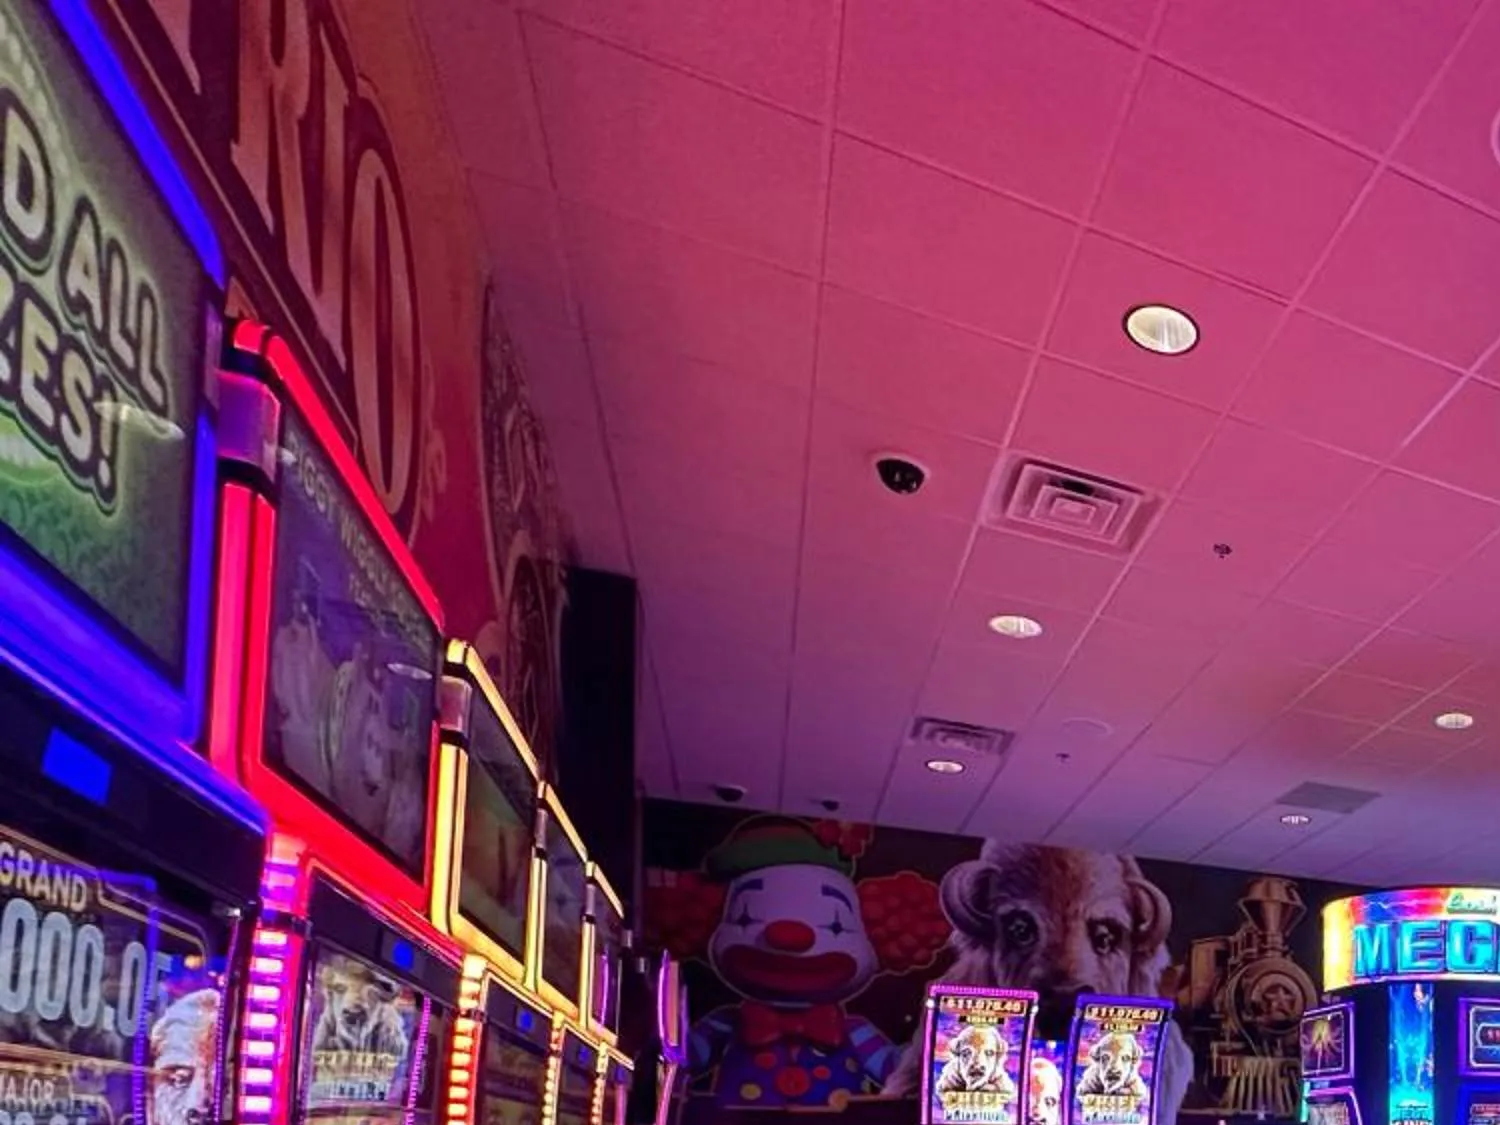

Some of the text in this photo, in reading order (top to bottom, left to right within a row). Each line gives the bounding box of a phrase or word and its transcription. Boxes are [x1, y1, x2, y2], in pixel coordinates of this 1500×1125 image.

[60, 200, 169, 419] ALL
[0, 842, 88, 911] GRAND
[0, 1070, 55, 1106] AJOR
